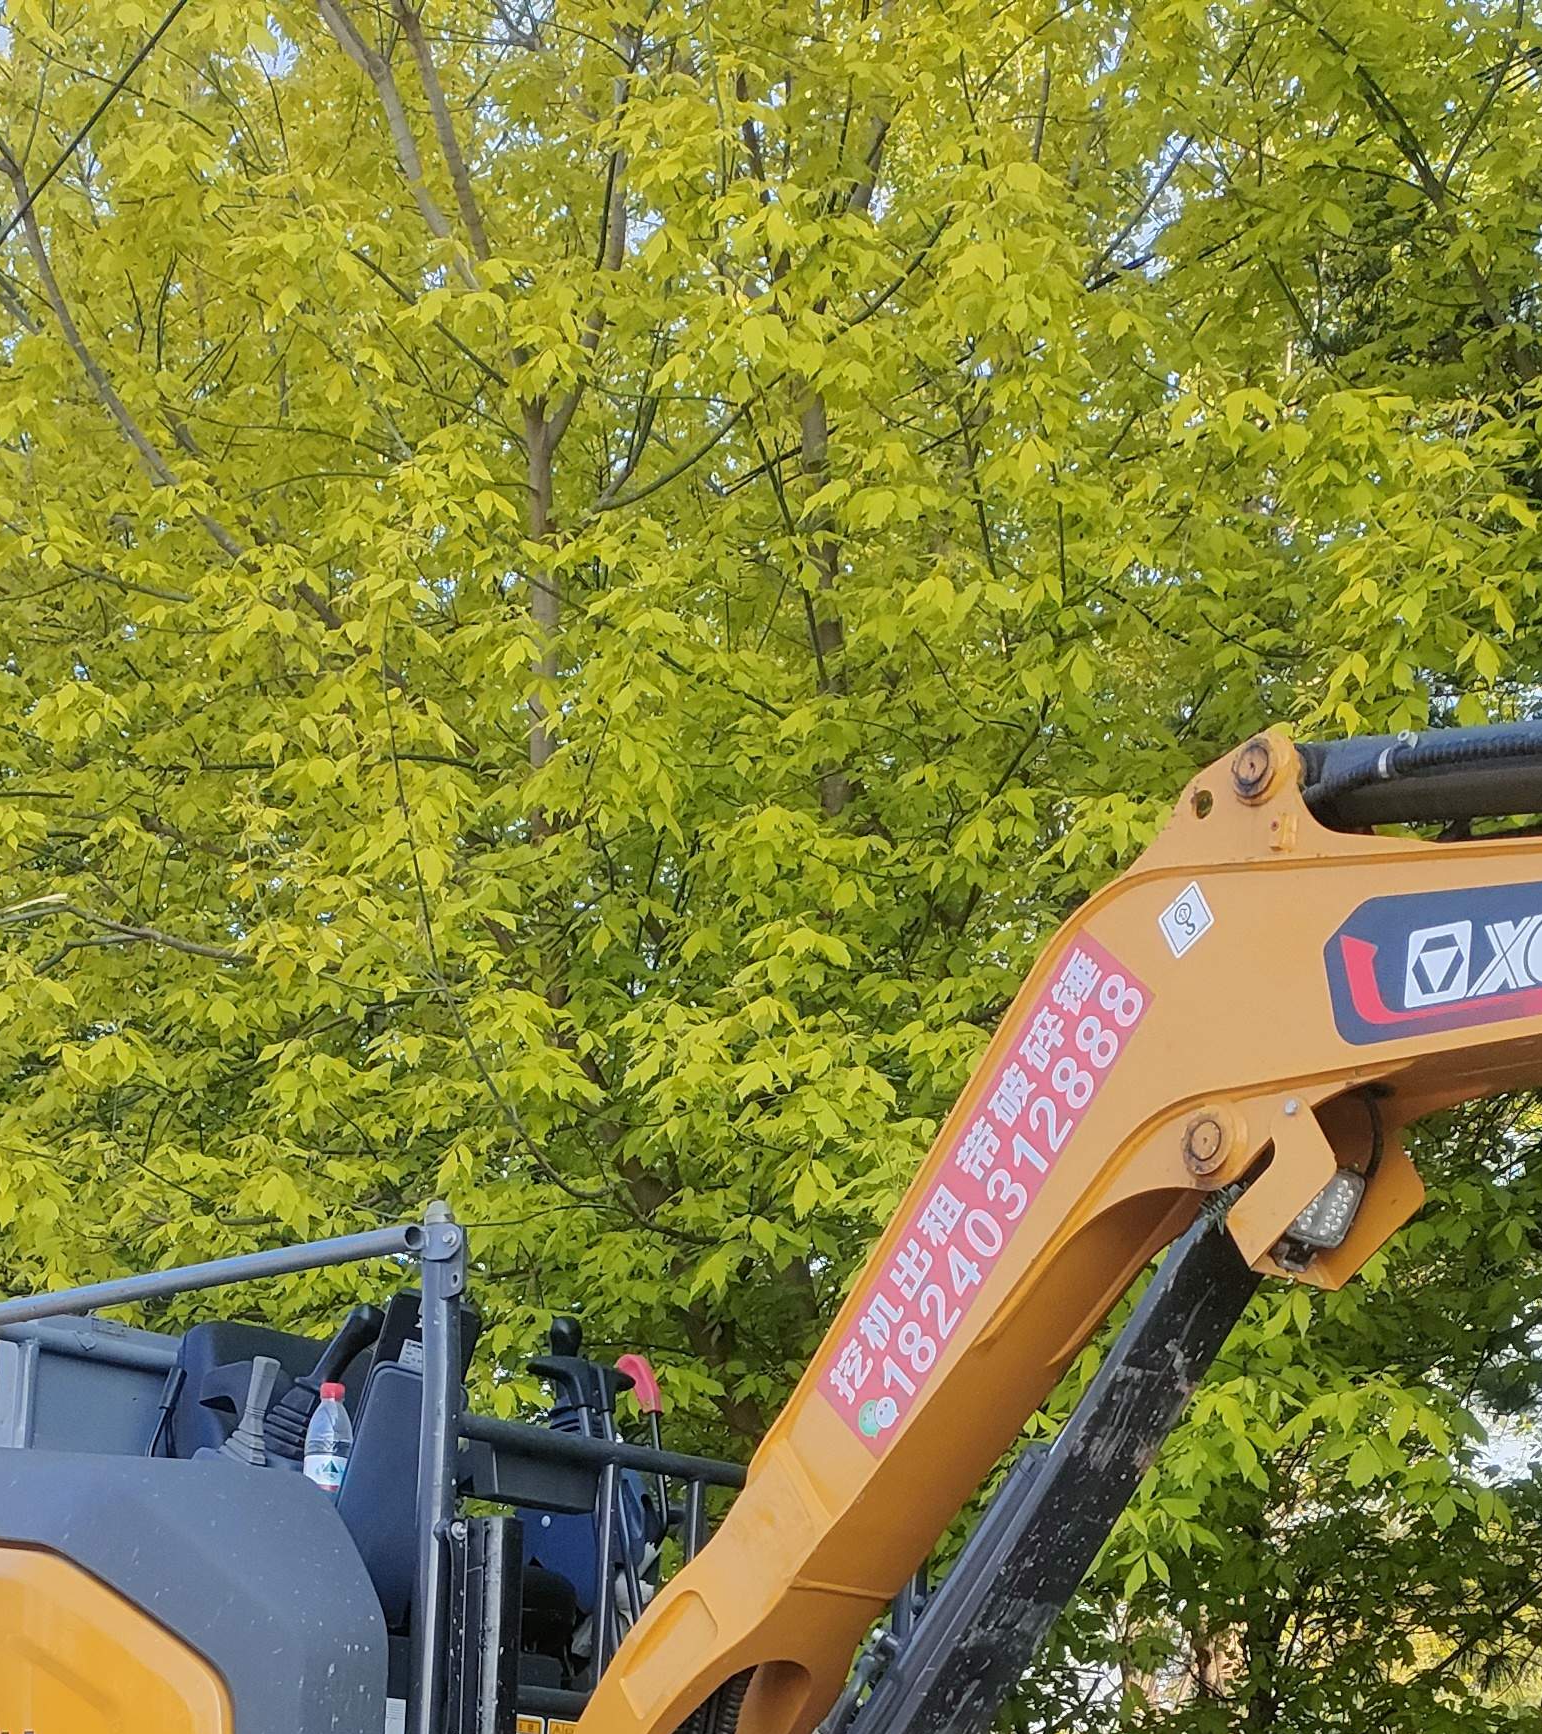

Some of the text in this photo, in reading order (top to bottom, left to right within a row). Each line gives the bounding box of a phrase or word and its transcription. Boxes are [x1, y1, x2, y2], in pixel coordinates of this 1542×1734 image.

[829, 946, 1102, 1404] 挖机出租 带破碎锤
[881, 973, 1144, 1397] 18240312888
